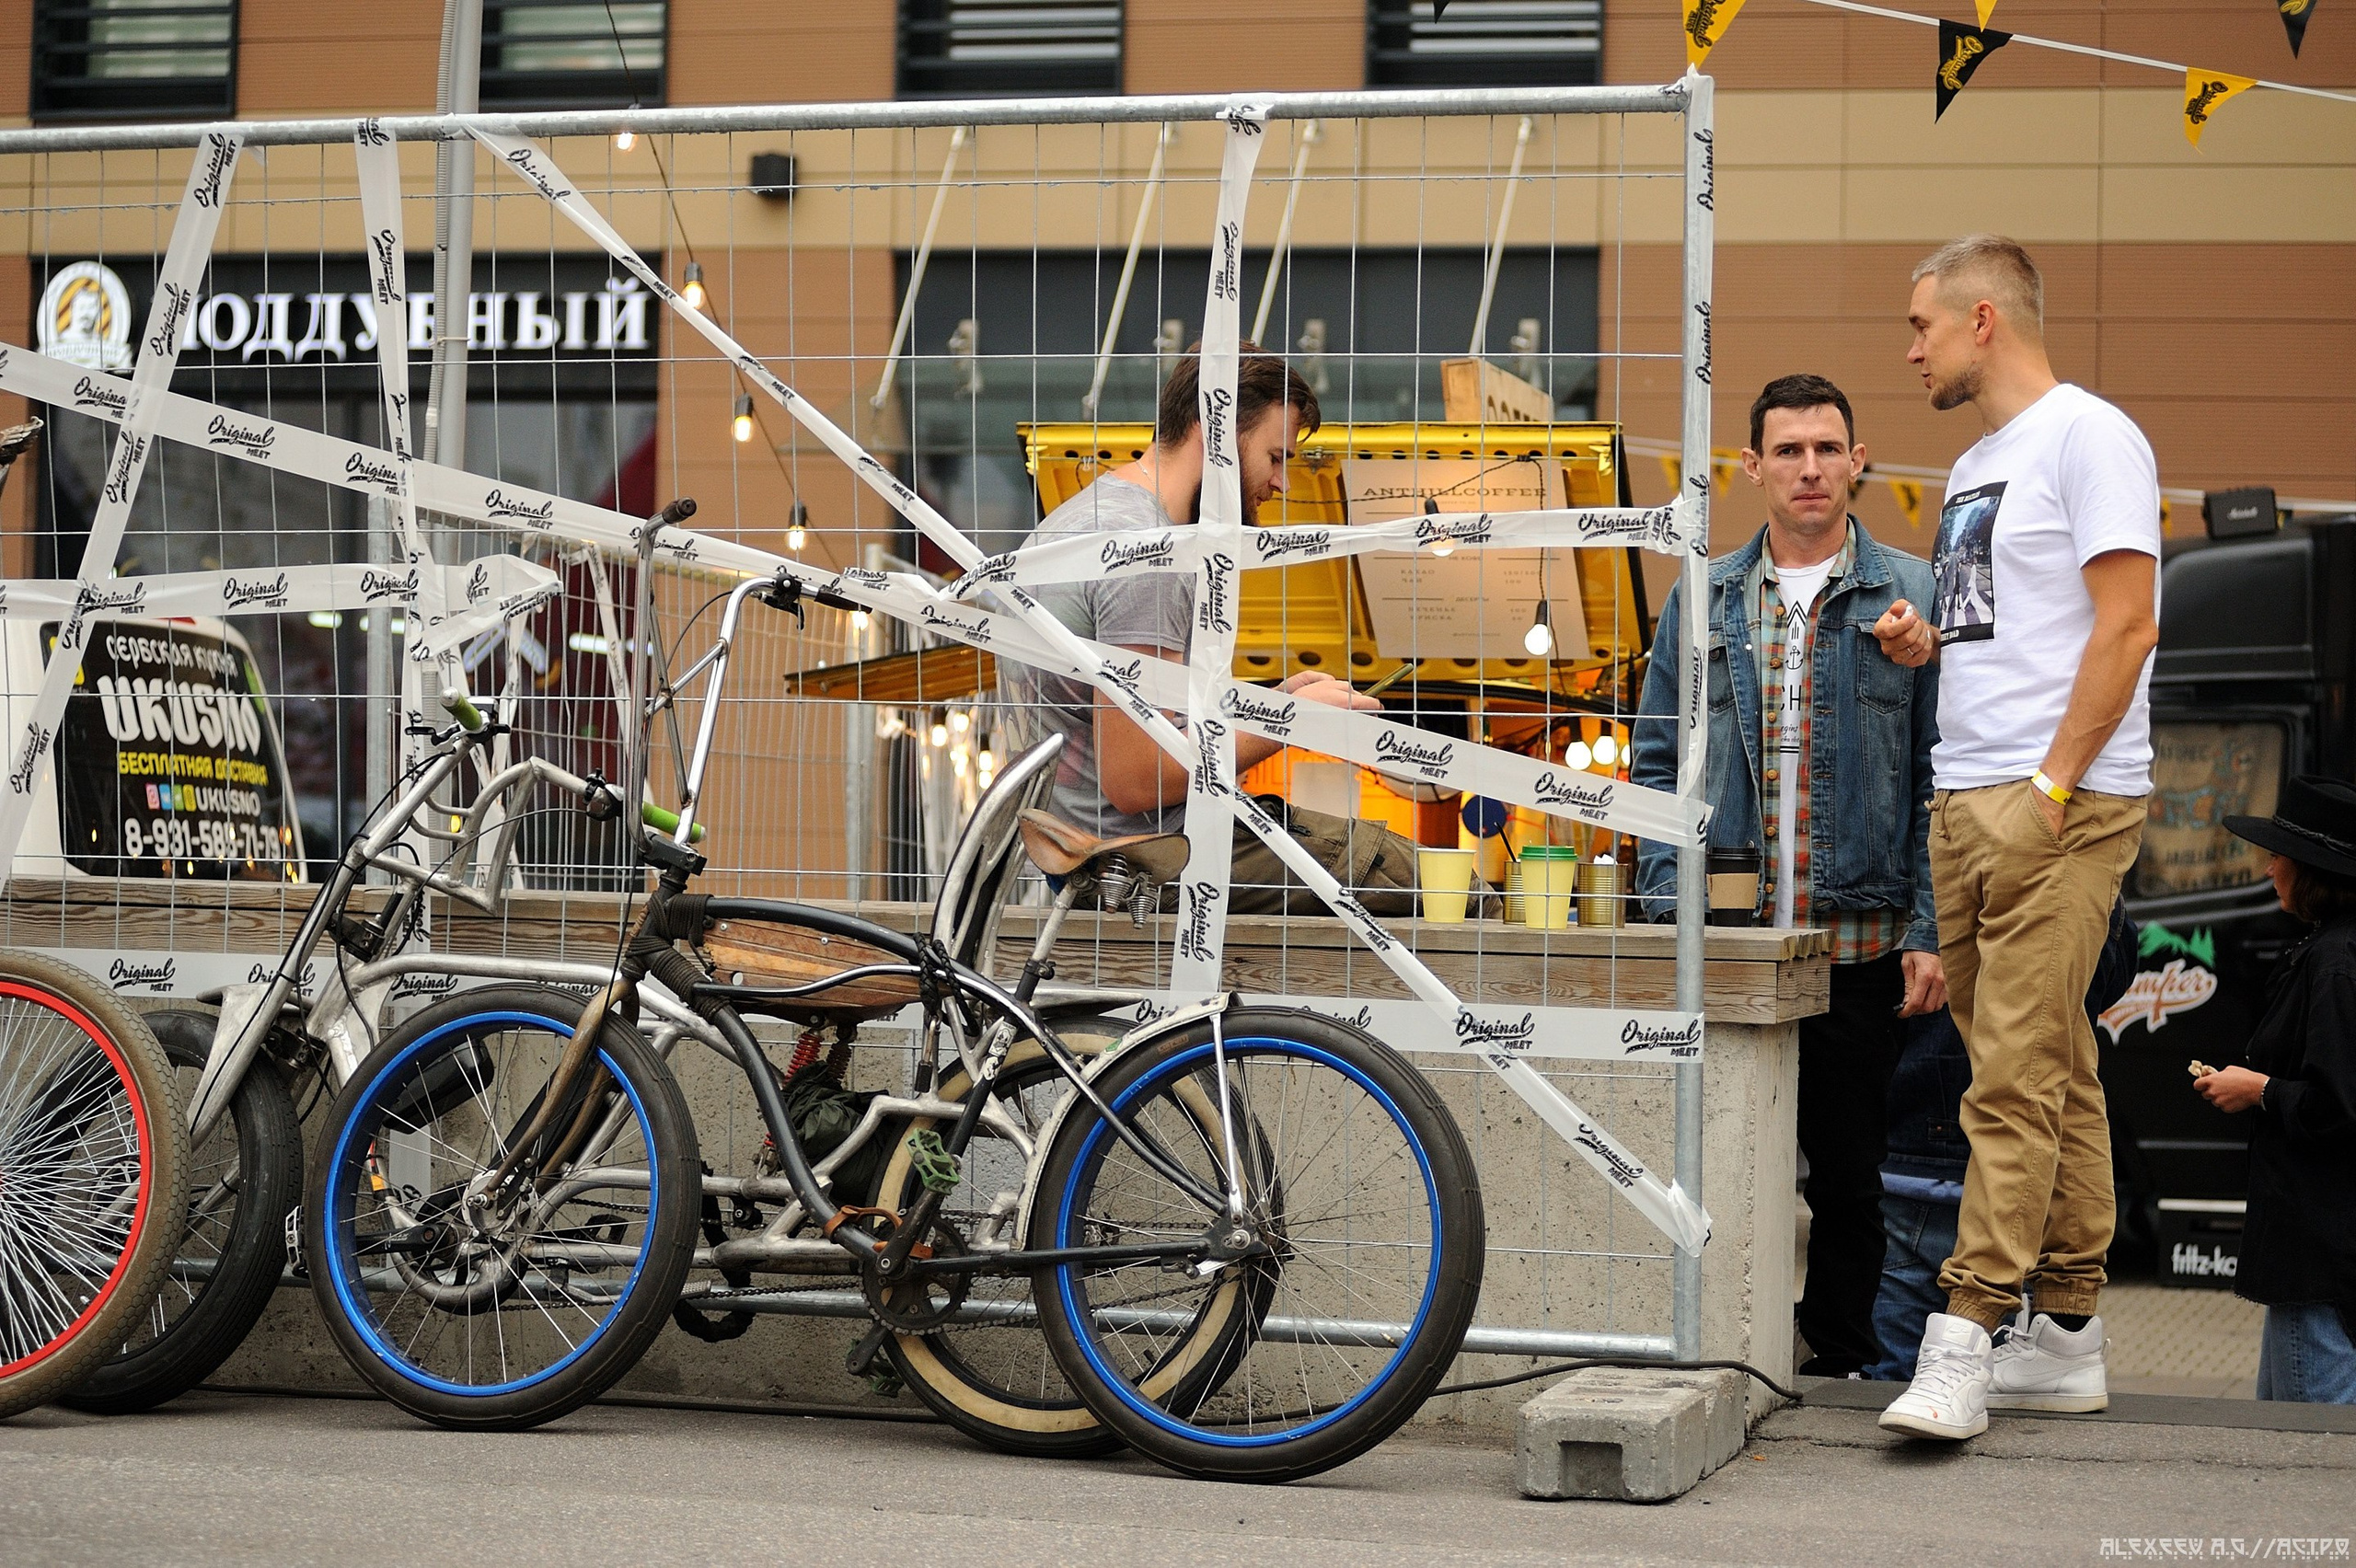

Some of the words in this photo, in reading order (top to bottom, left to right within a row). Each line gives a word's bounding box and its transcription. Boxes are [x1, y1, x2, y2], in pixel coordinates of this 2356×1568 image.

[224, 139, 237, 167] MEET
[194, 133, 226, 209] Original
[179, 288, 191, 317] MEET
[376, 277, 389, 306] MEET
[653, 281, 677, 300] MEET
[150, 282, 180, 358] Original
[771, 381, 795, 400] MEET
[208, 414, 275, 448] Original
[1212, 387, 1233, 468] Original
[133, 436, 146, 465] MEET
[246, 447, 271, 460] MEET
[105, 430, 135, 504] Original
[485, 489, 554, 520] Original
[892, 483, 916, 502] MEET
[526, 519, 554, 531] MEET
[1415, 513, 1494, 542] Original
[1626, 531, 1648, 541] MEE
[1100, 531, 1174, 567] Original
[1256, 530, 1331, 554] Original
[1303, 544, 1332, 557] MEET
[1463, 534, 1493, 545] MEET
[947, 551, 1017, 596] Original
[1148, 557, 1174, 568] MEET
[224, 572, 289, 605] Original
[360, 568, 420, 596] Original
[988, 571, 1017, 583] MEET
[264, 597, 288, 608] MEET
[1011, 589, 1036, 609] MEET
[1207, 552, 1235, 634] Original
[121, 605, 145, 615] MEET
[920, 605, 991, 635] Original
[1199, 601, 1209, 631] MEET
[964, 629, 992, 645] MEET
[1128, 699, 1154, 722] MEET
[1218, 687, 1297, 725] Original
[38, 728, 52, 756] MEET
[1263, 722, 1291, 737] MEET
[10, 721, 40, 795] Original
[1201, 719, 1230, 798] Original
[1374, 730, 1454, 767] Original
[119, 751, 214, 779] БЕСПЛАТНАЯ
[1195, 764, 1205, 794] MEET
[1419, 766, 1449, 779] MEET
[195, 786, 261, 817] UKUSNO
[1533, 771, 1615, 809] Original
[1247, 813, 1274, 836] MEET
[1578, 807, 1609, 822] MEET
[1191, 881, 1220, 963] Original
[1180, 928, 1190, 959] MEET
[1365, 930, 1392, 952] MEET
[109, 957, 176, 987] Original
[150, 983, 174, 992] MEET
[1455, 1011, 1536, 1043] Original
[1620, 1019, 1703, 1049] Original
[1503, 1040, 1533, 1051] MEET
[1669, 1046, 1700, 1057] MEET
[1577, 1122, 1645, 1179] Original
[1607, 1166, 1634, 1189] MEET
